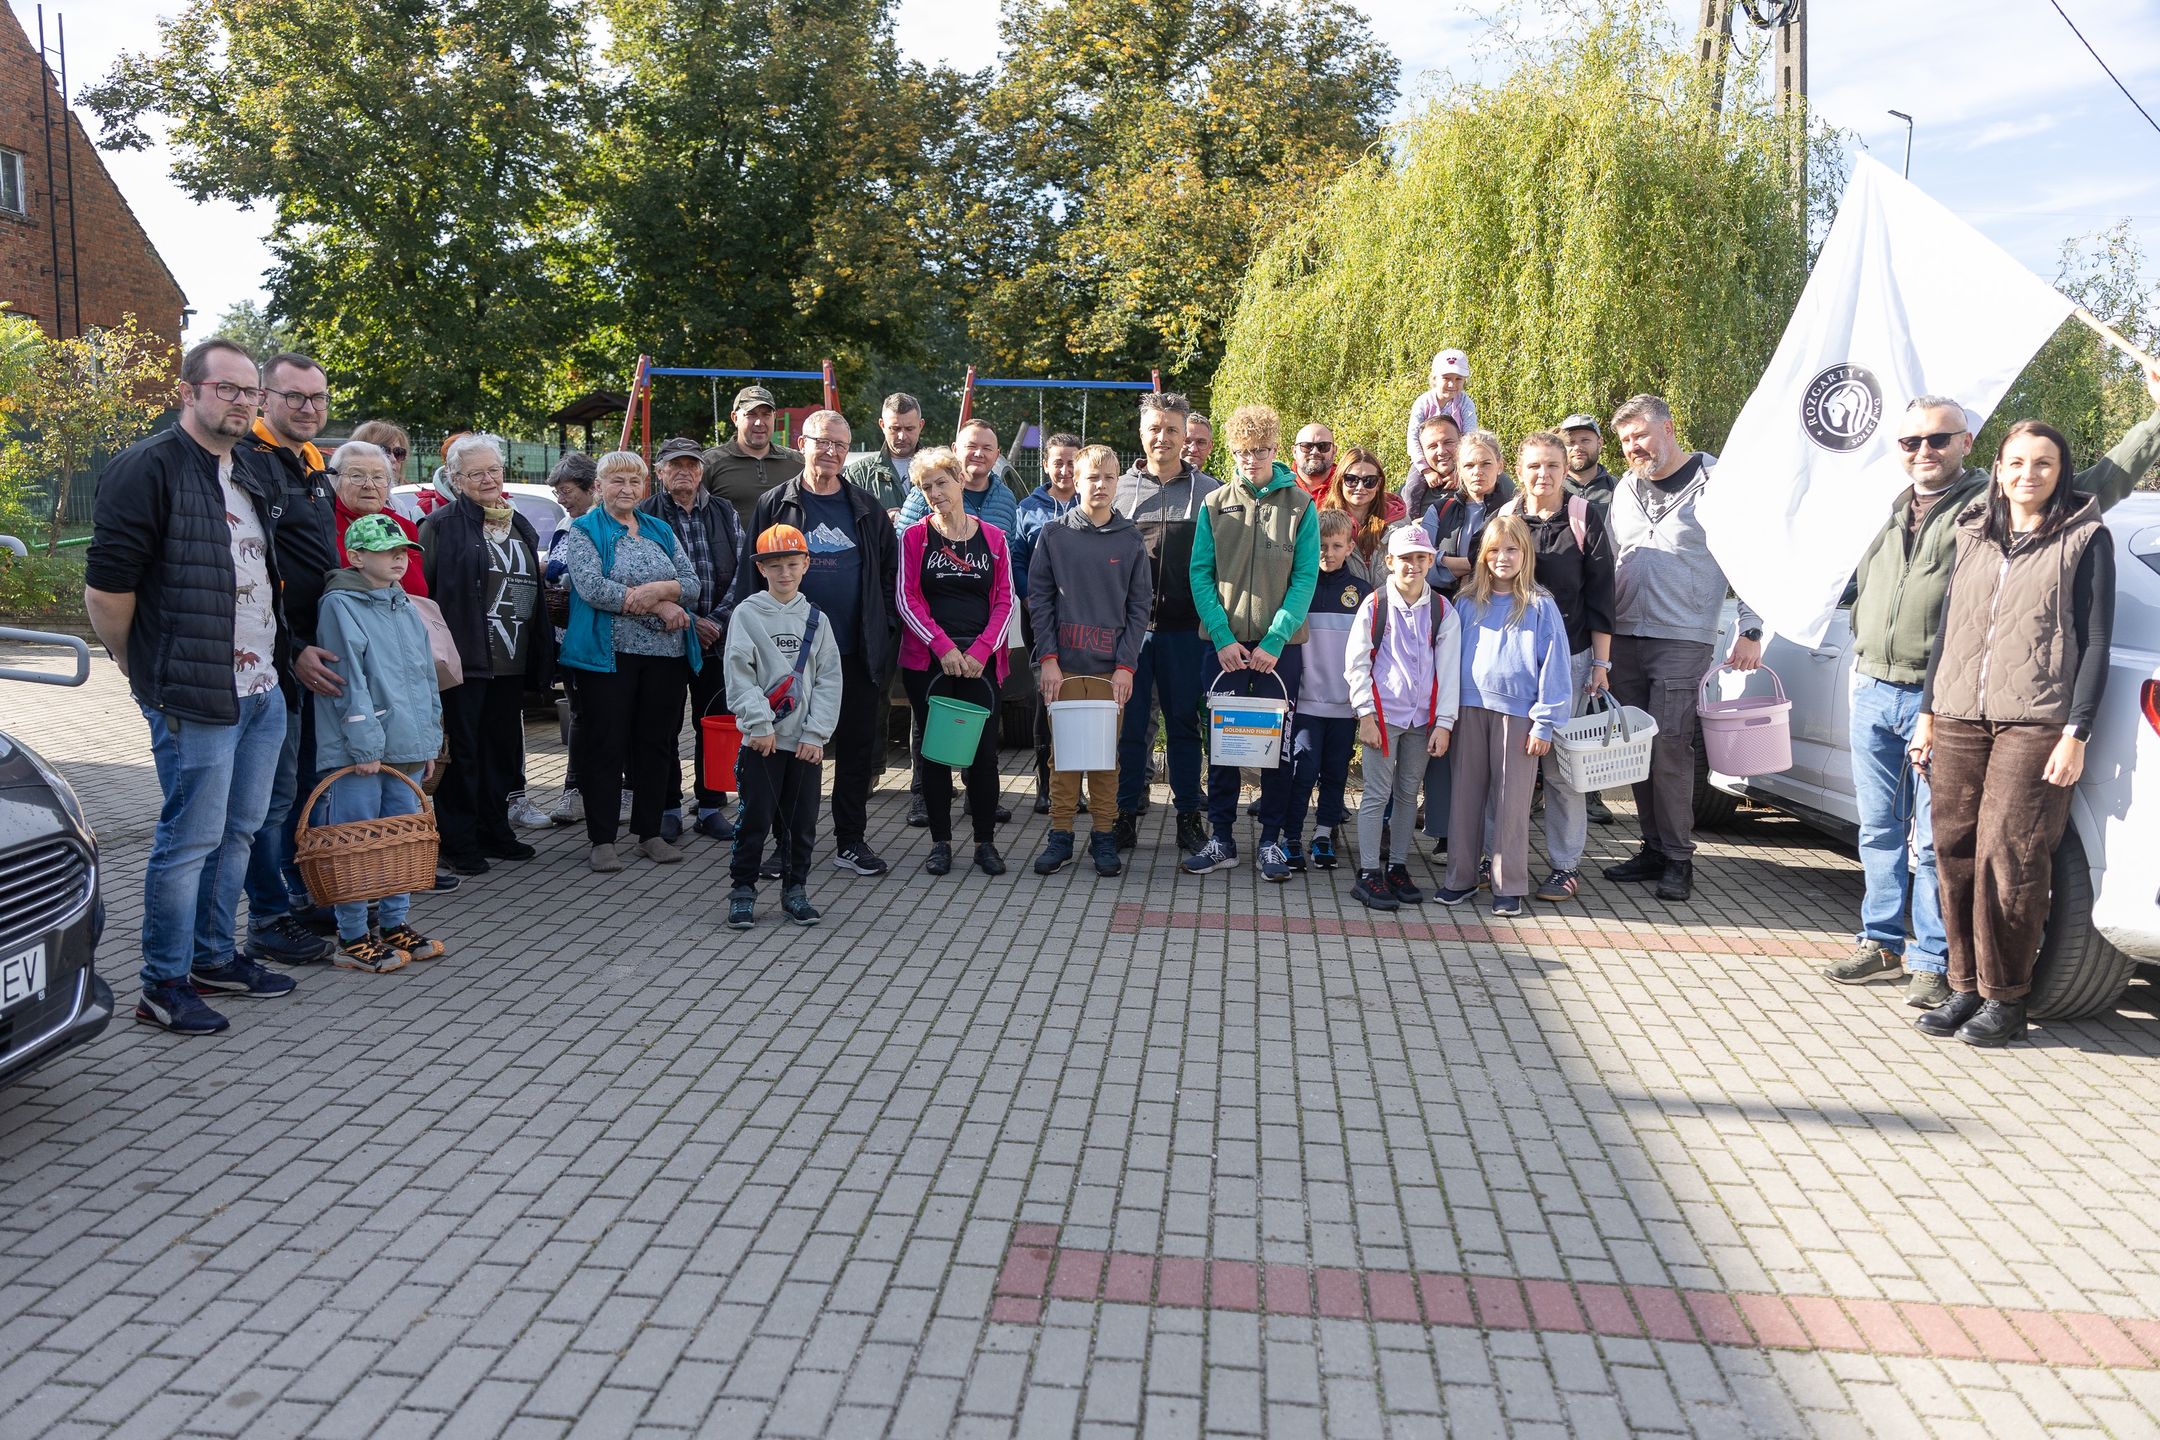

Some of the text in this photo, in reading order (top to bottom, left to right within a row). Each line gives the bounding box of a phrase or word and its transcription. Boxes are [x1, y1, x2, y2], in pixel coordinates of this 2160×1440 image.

[1805, 368, 1855, 427] ROZGARTY
[487, 618, 524, 660] V
[1059, 622, 1116, 654] NIKE
[1281, 710, 1295, 762] LEGEA
[3, 950, 38, 1005] EV
